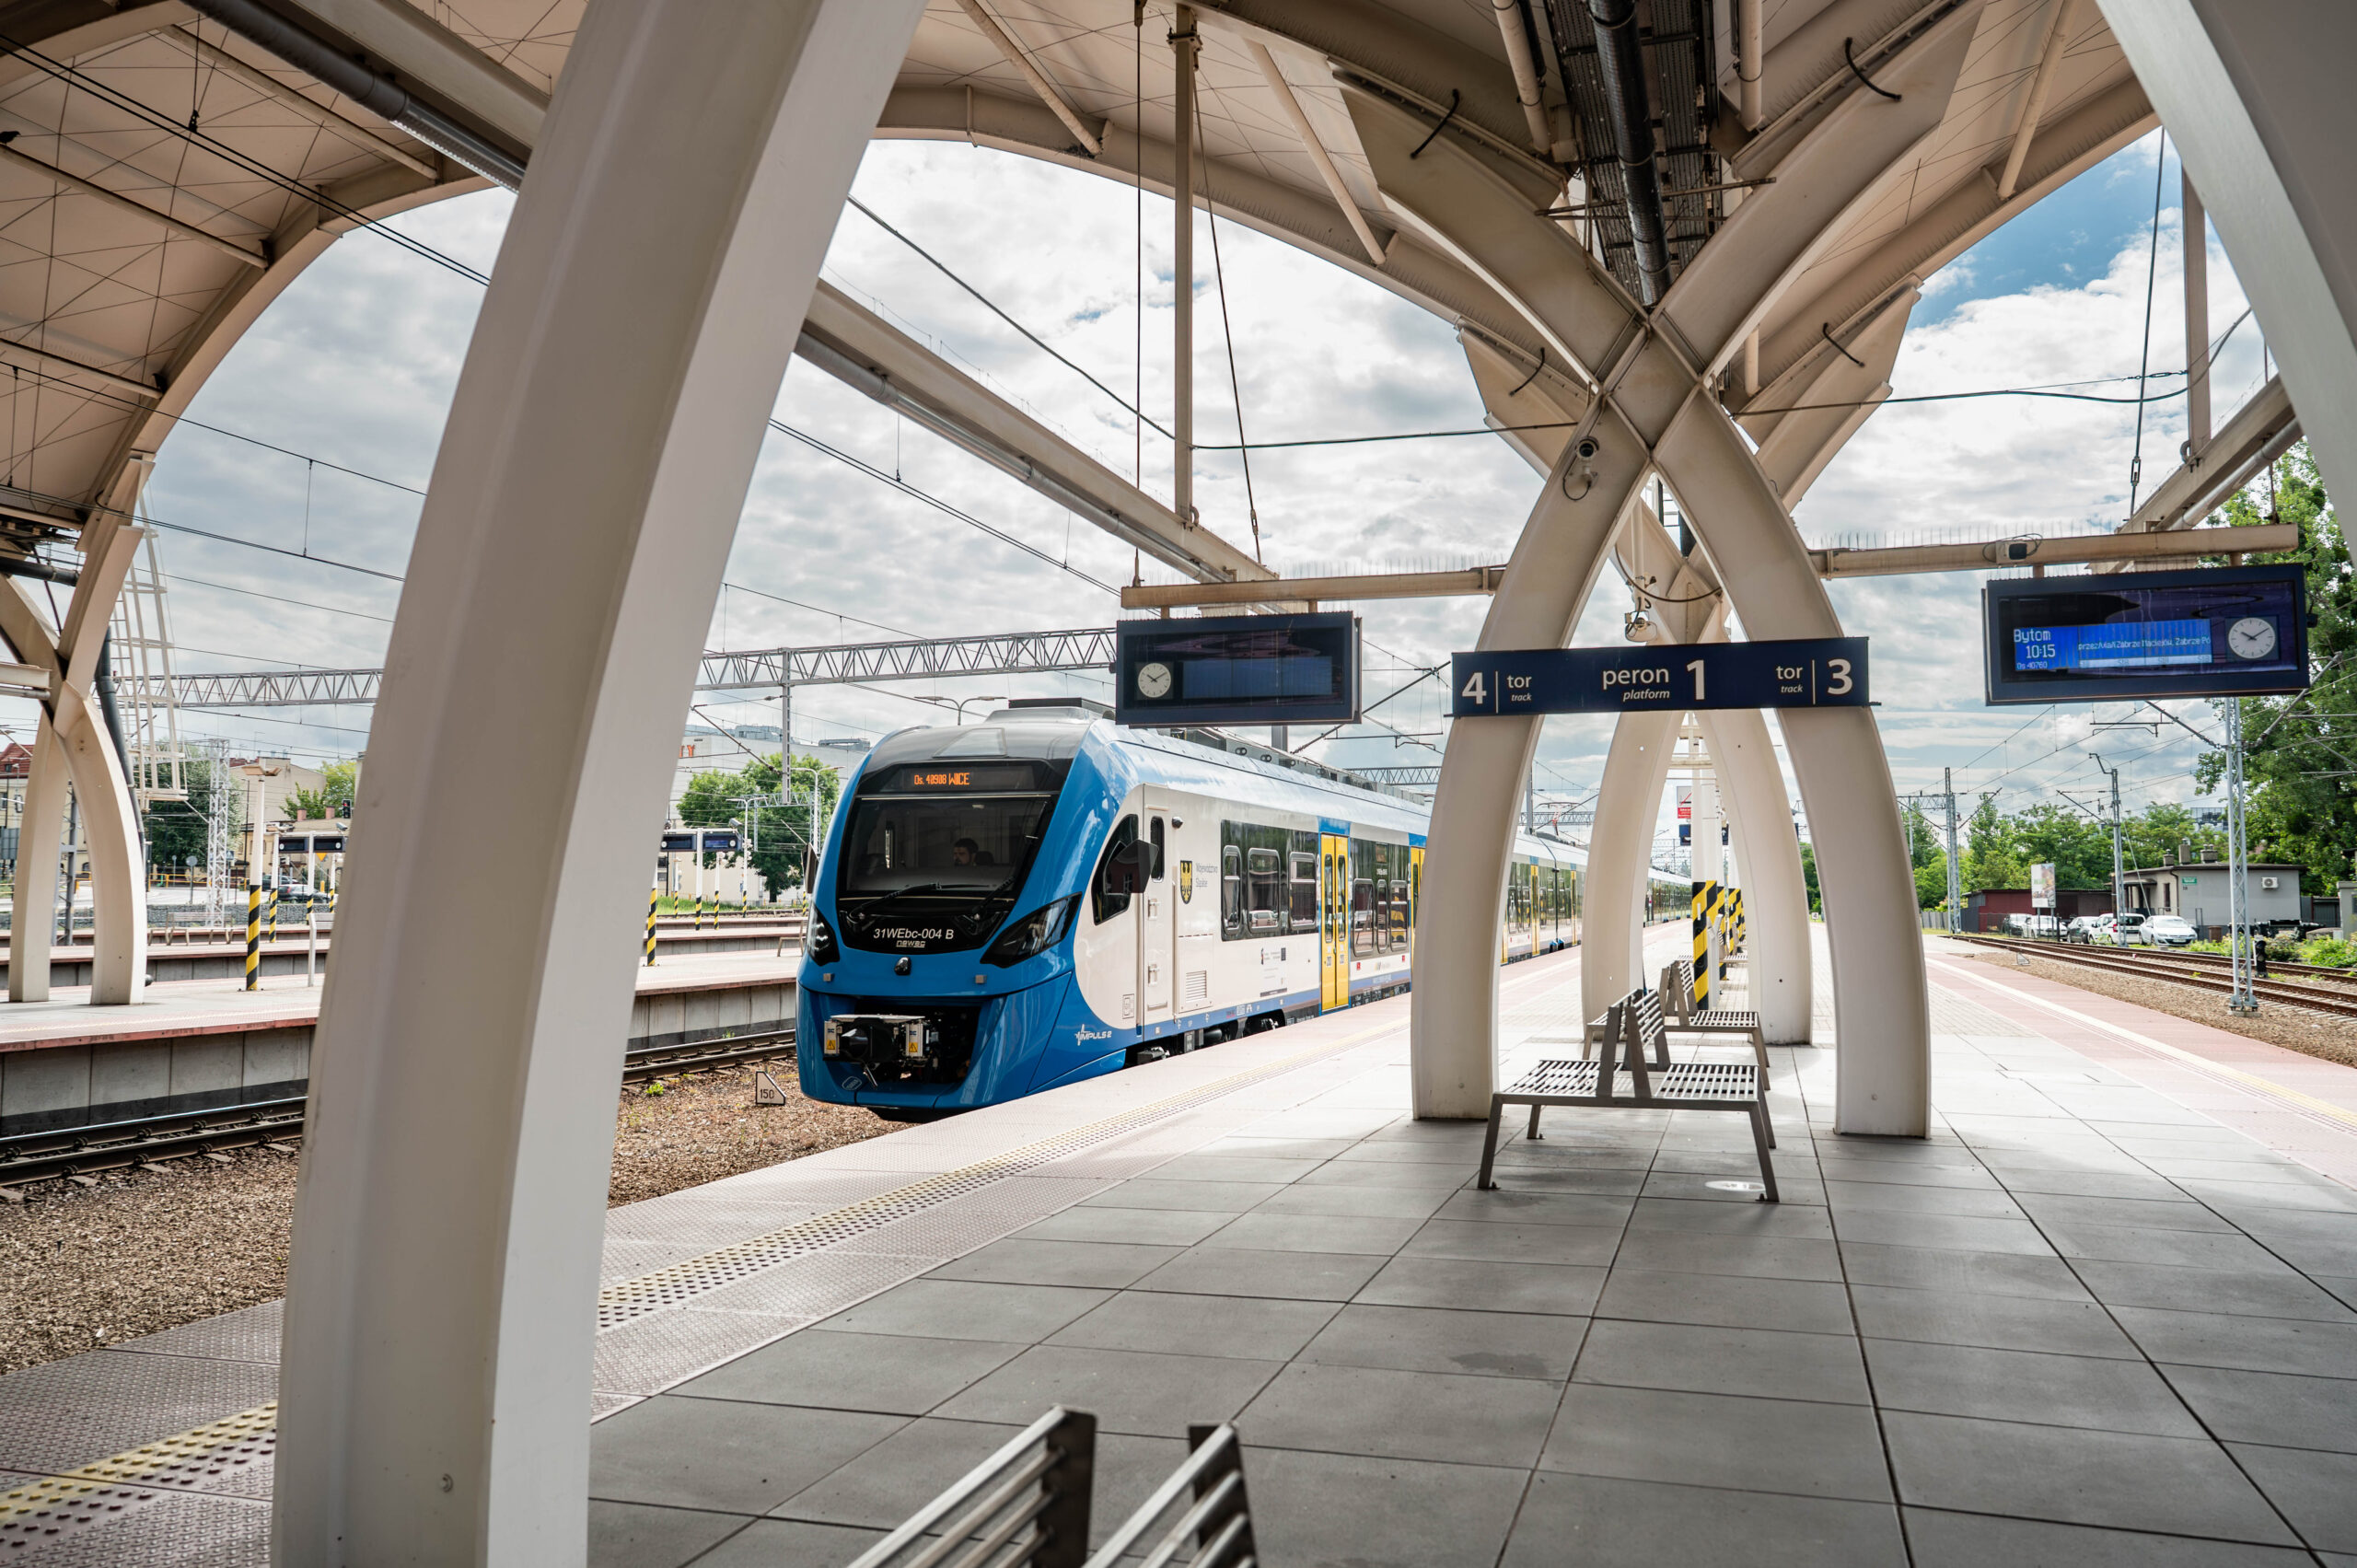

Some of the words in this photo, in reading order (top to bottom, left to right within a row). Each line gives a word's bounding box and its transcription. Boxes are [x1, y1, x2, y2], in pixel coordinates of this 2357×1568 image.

[2014, 629, 2051, 644] Bytom
[2026, 644, 2056, 659] 10:15
[1602, 668, 1669, 691] peron
[1686, 659, 1705, 701] 1
[1775, 666, 1804, 680] tor
[1827, 658, 1853, 695] 3
[1461, 671, 1487, 704] 4
[1506, 675, 1532, 689] tor
[1781, 683, 1804, 693] track
[1511, 692, 1533, 702] track
[1622, 688, 1671, 703] platform
[948, 772, 971, 785] WICE
[873, 928, 943, 939] 31WEbc-004
[945, 929, 955, 940] B
